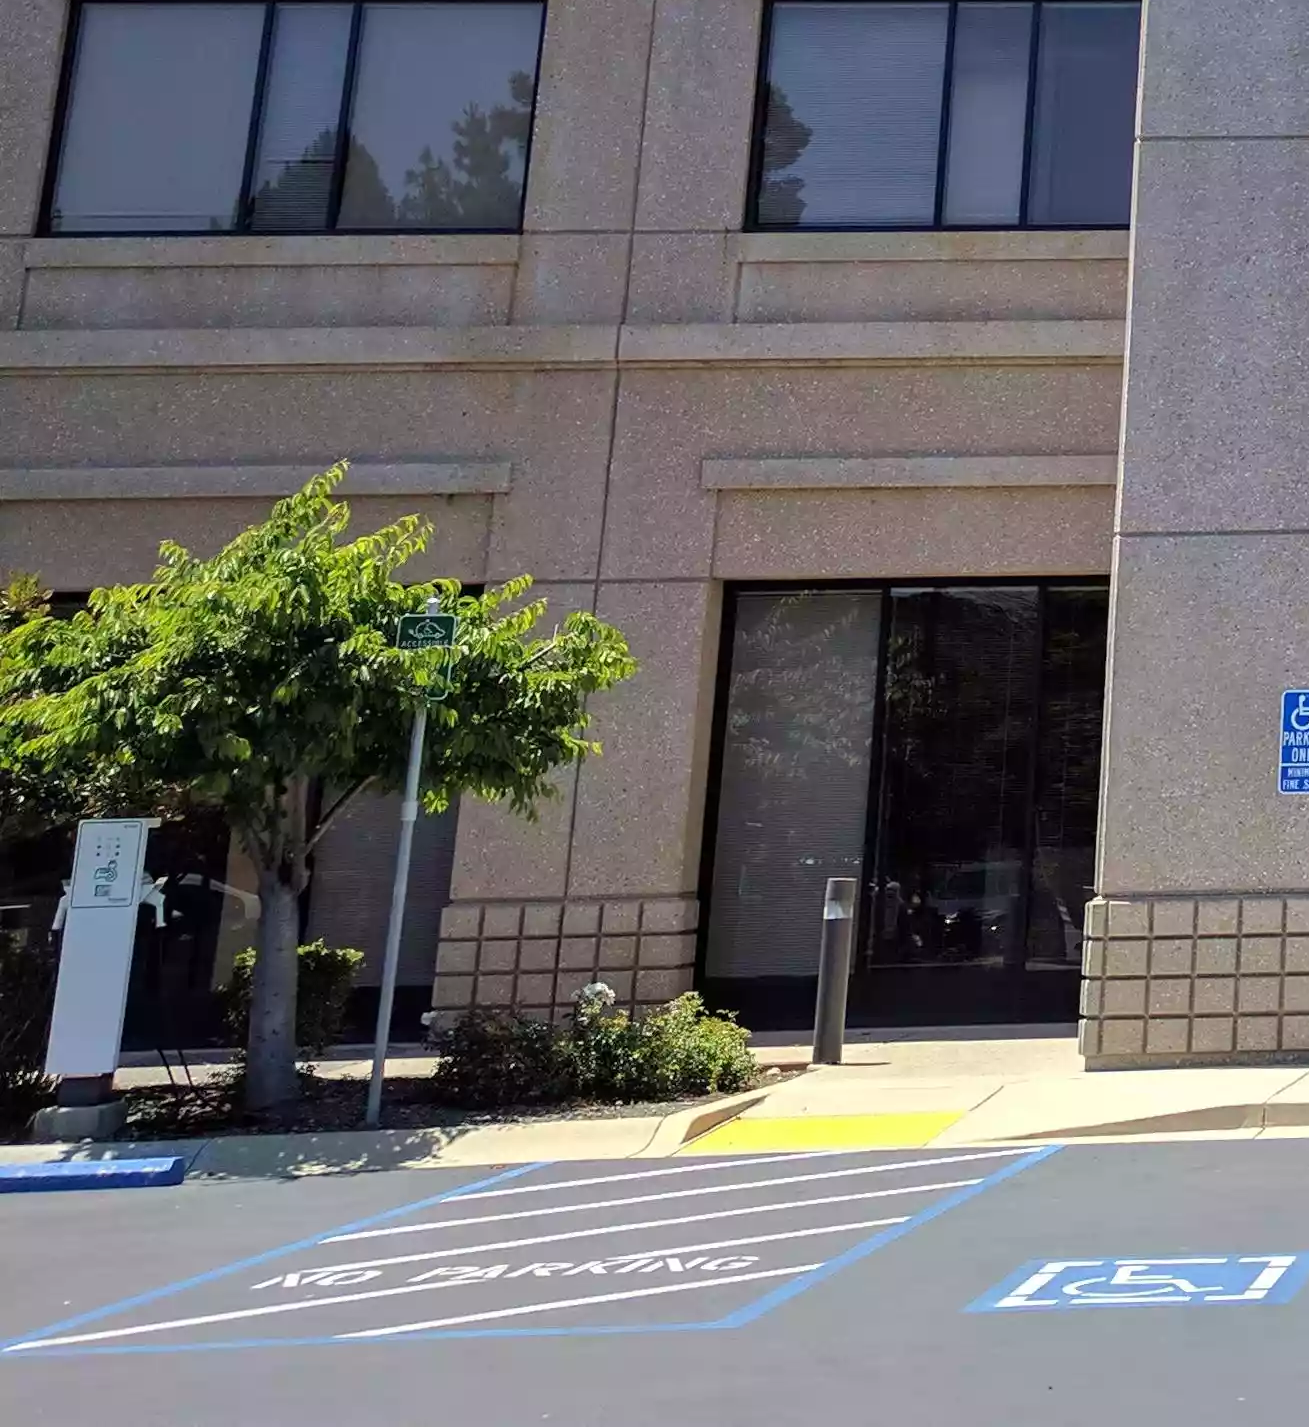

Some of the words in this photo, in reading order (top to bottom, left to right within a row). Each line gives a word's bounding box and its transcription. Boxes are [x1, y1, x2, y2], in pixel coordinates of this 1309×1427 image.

[1282, 780, 1299, 790] FINE
[250, 1269, 384, 1289] NO
[405, 1255, 761, 1284] PARKING
